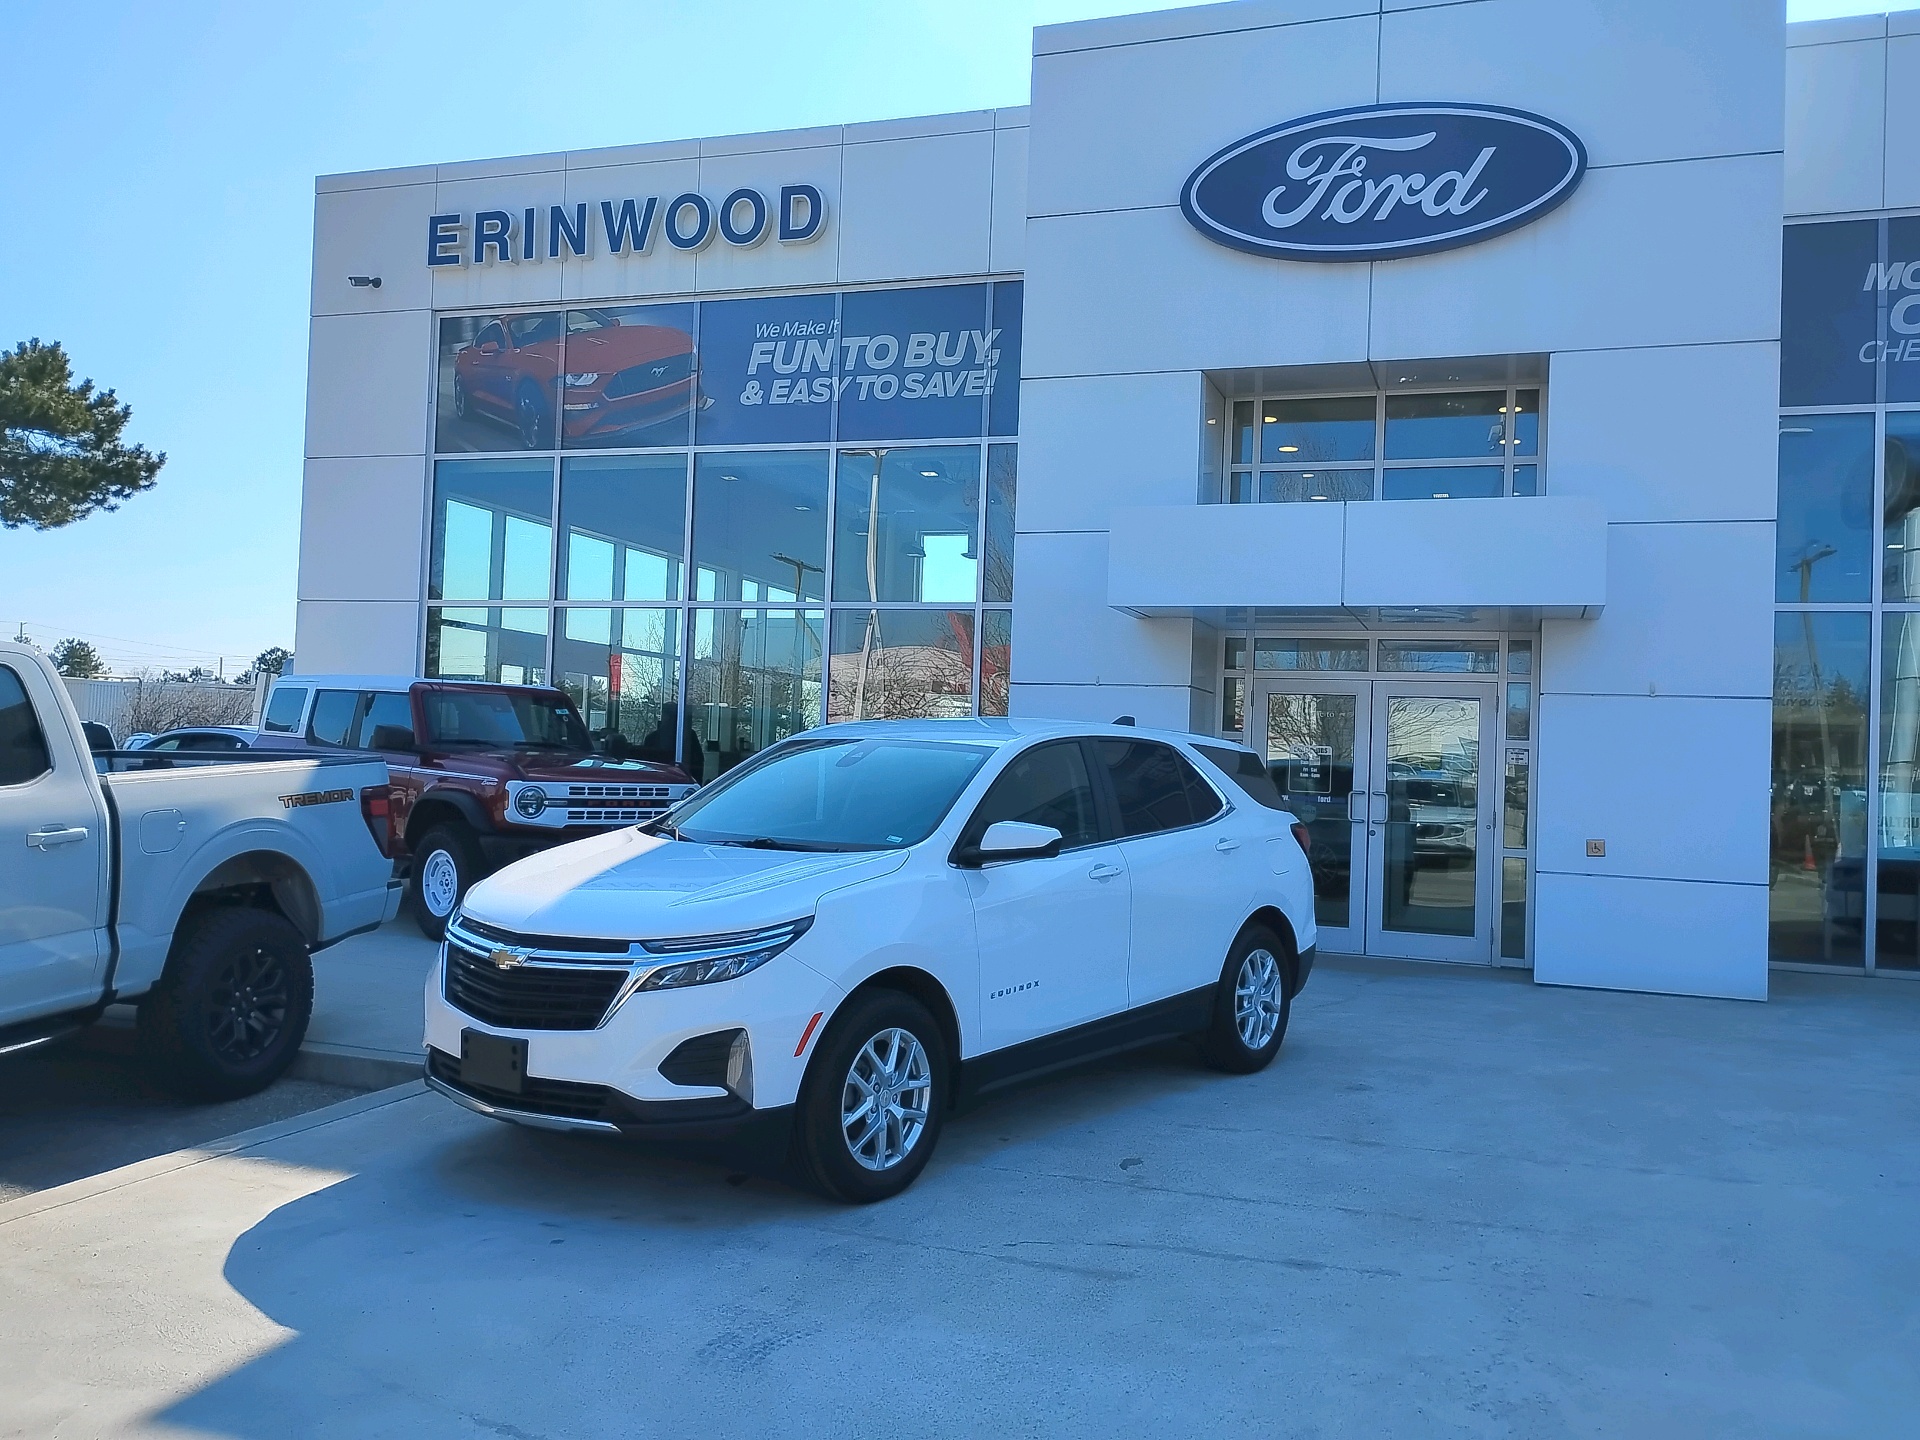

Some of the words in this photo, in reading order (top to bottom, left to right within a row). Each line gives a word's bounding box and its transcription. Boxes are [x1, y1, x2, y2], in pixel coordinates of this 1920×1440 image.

[1261, 131, 1497, 229] Ford
[427, 184, 826, 269] ERINWOOD
[755, 323, 780, 338] We
[782, 319, 826, 337] Make
[828, 318, 840, 333] It
[747, 338, 836, 376] FUN
[841, 335, 899, 372] TO
[903, 328, 1003, 368] BUY,
[1858, 339, 1920, 363] CHE
[740, 381, 763, 405] &
[768, 376, 854, 405] EASY
[855, 374, 899, 401] TO
[900, 369, 998, 400] SAVE!
[278, 787, 355, 809] TREMOR
[990, 980, 1040, 1000] EQUINOX
